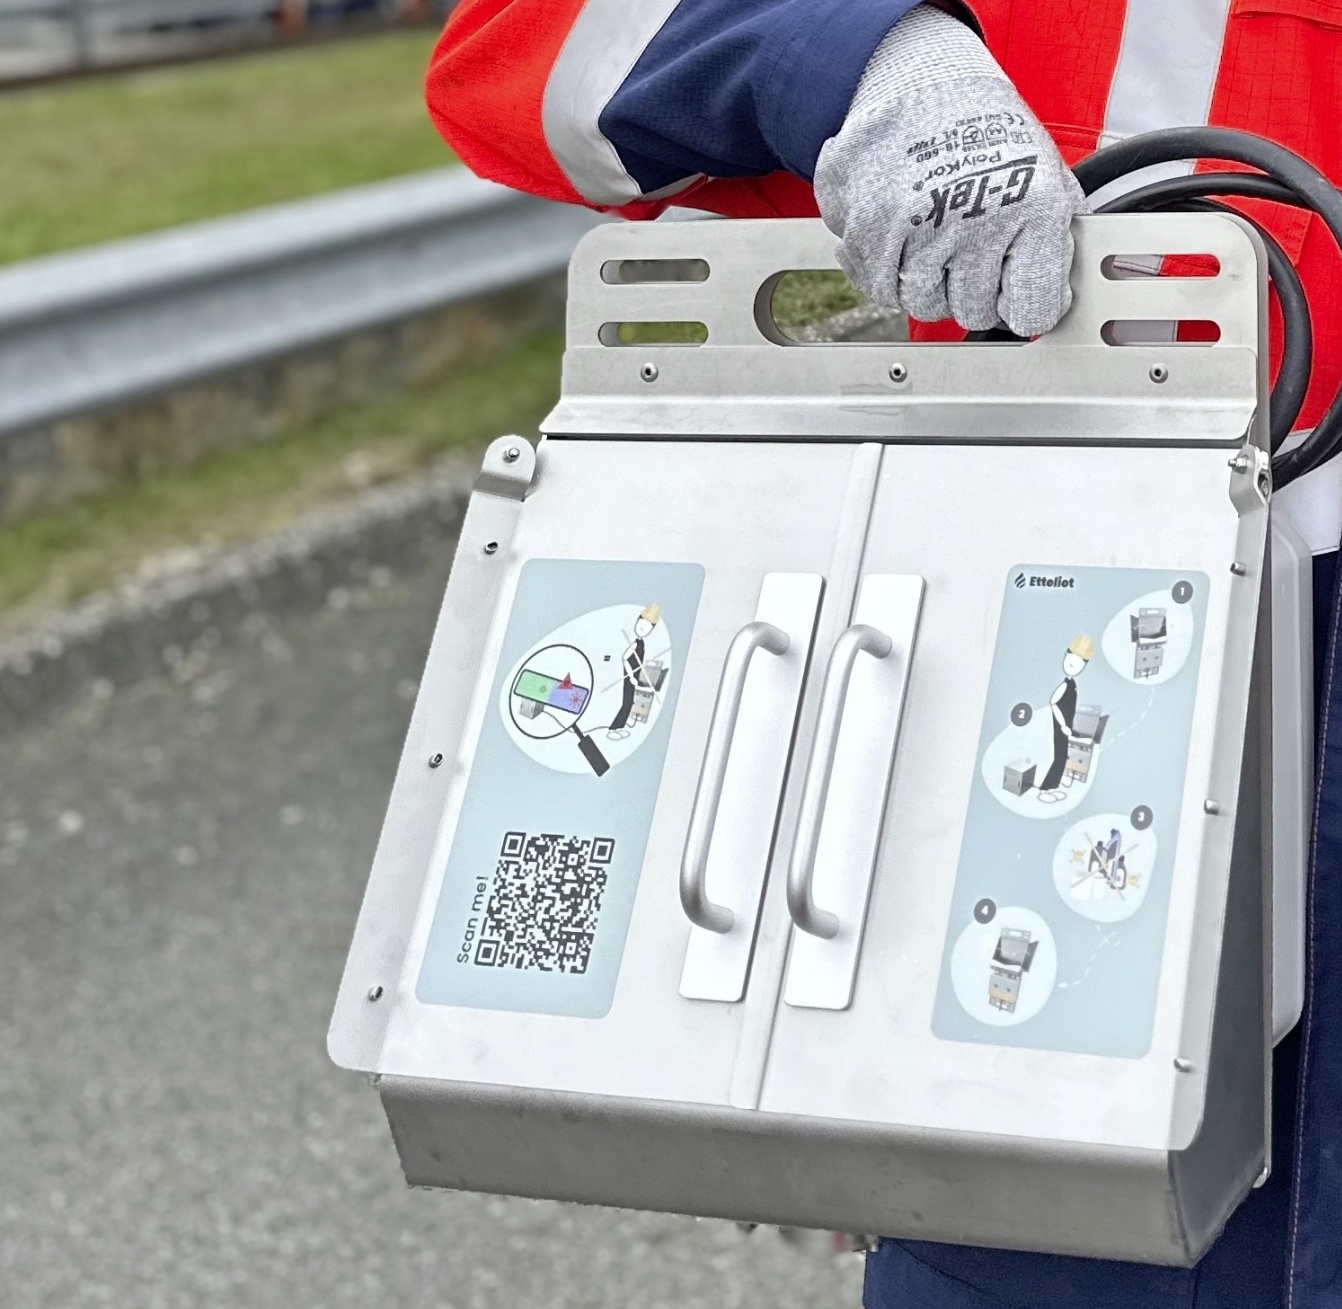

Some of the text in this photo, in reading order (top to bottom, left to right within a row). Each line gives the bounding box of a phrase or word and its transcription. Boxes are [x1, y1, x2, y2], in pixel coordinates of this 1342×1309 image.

[1029, 575, 1075, 589] Etteliot
[456, 875, 489, 964] Scan me!
